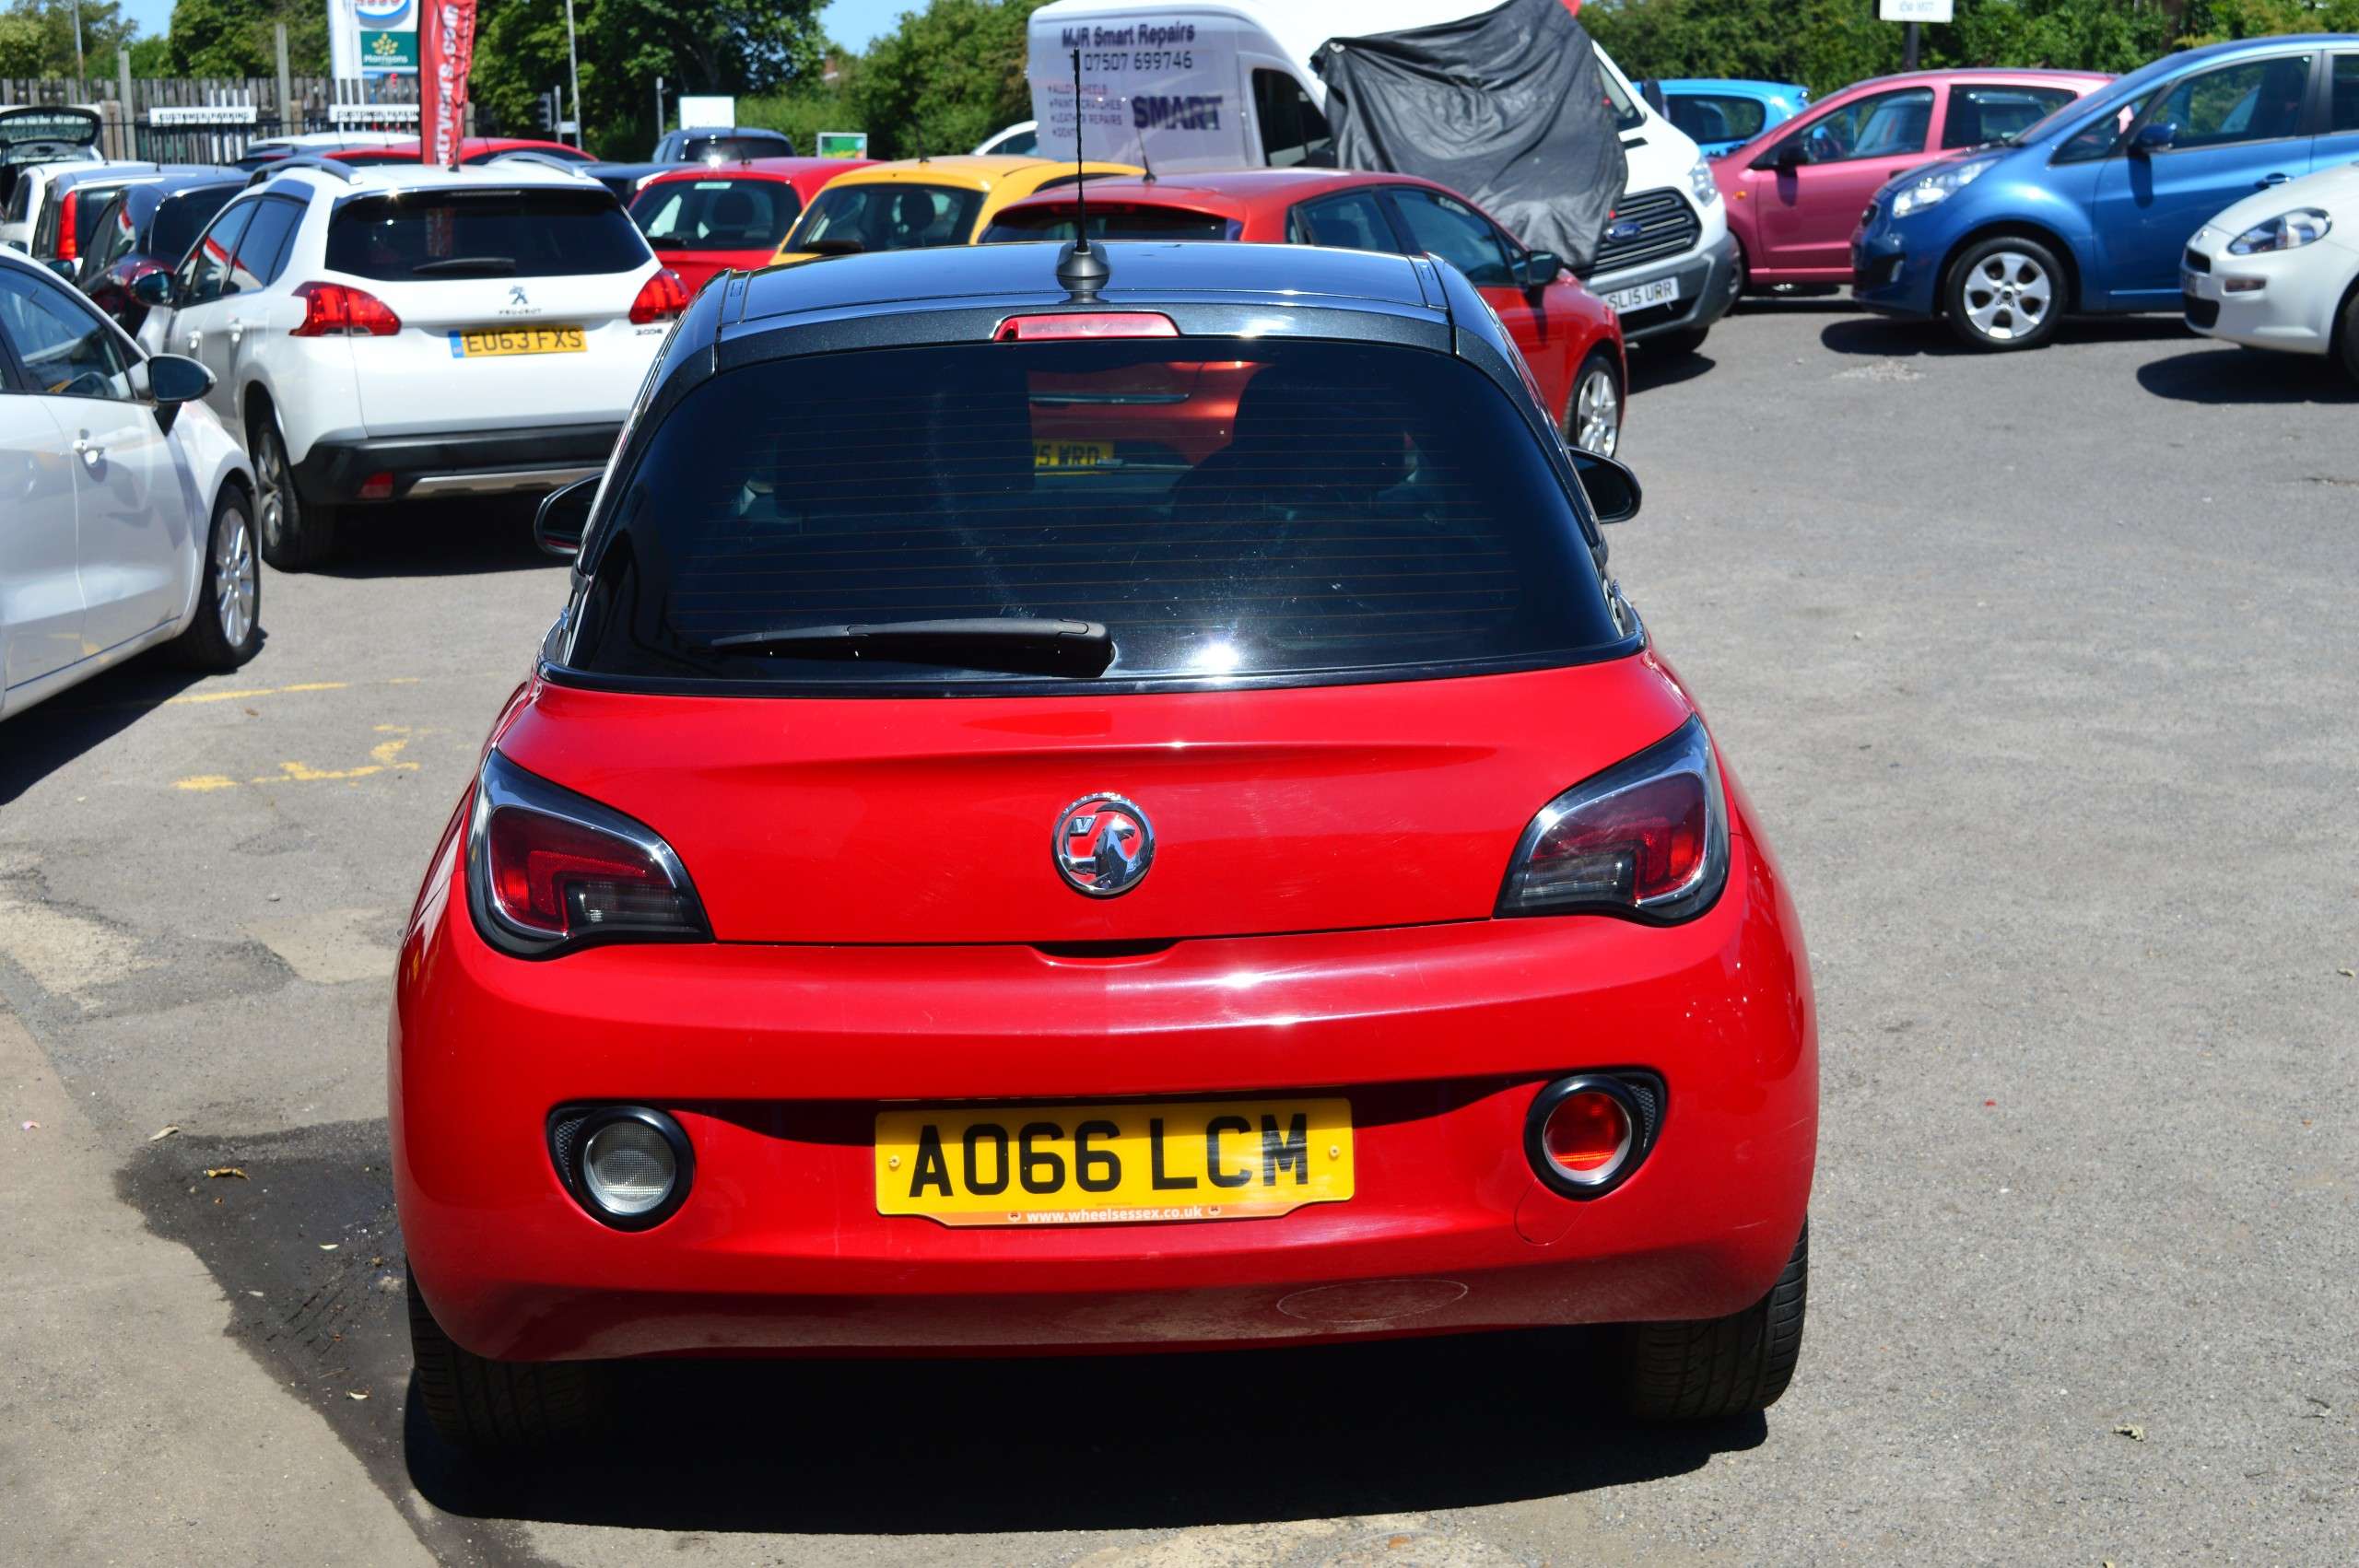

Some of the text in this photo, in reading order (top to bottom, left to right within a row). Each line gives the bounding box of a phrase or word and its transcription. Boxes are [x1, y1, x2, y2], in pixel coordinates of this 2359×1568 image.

[1062, 21, 1195, 49] MJR Smart Repairs
[1084, 53, 1128, 71] 07507
[1134, 51, 1193, 70] 699746
[158, 111, 250, 121] CUSTOMER PARKING
[337, 110, 384, 118] CUSTOMER
[1131, 95, 1223, 130] SMART
[1608, 281, 1672, 310] SL15 URR
[466, 330, 582, 353] EU63 FXS
[910, 1114, 1308, 1198] AO66 LCM
[1026, 1206, 1203, 1223] www.wheelsessex.co.uk
